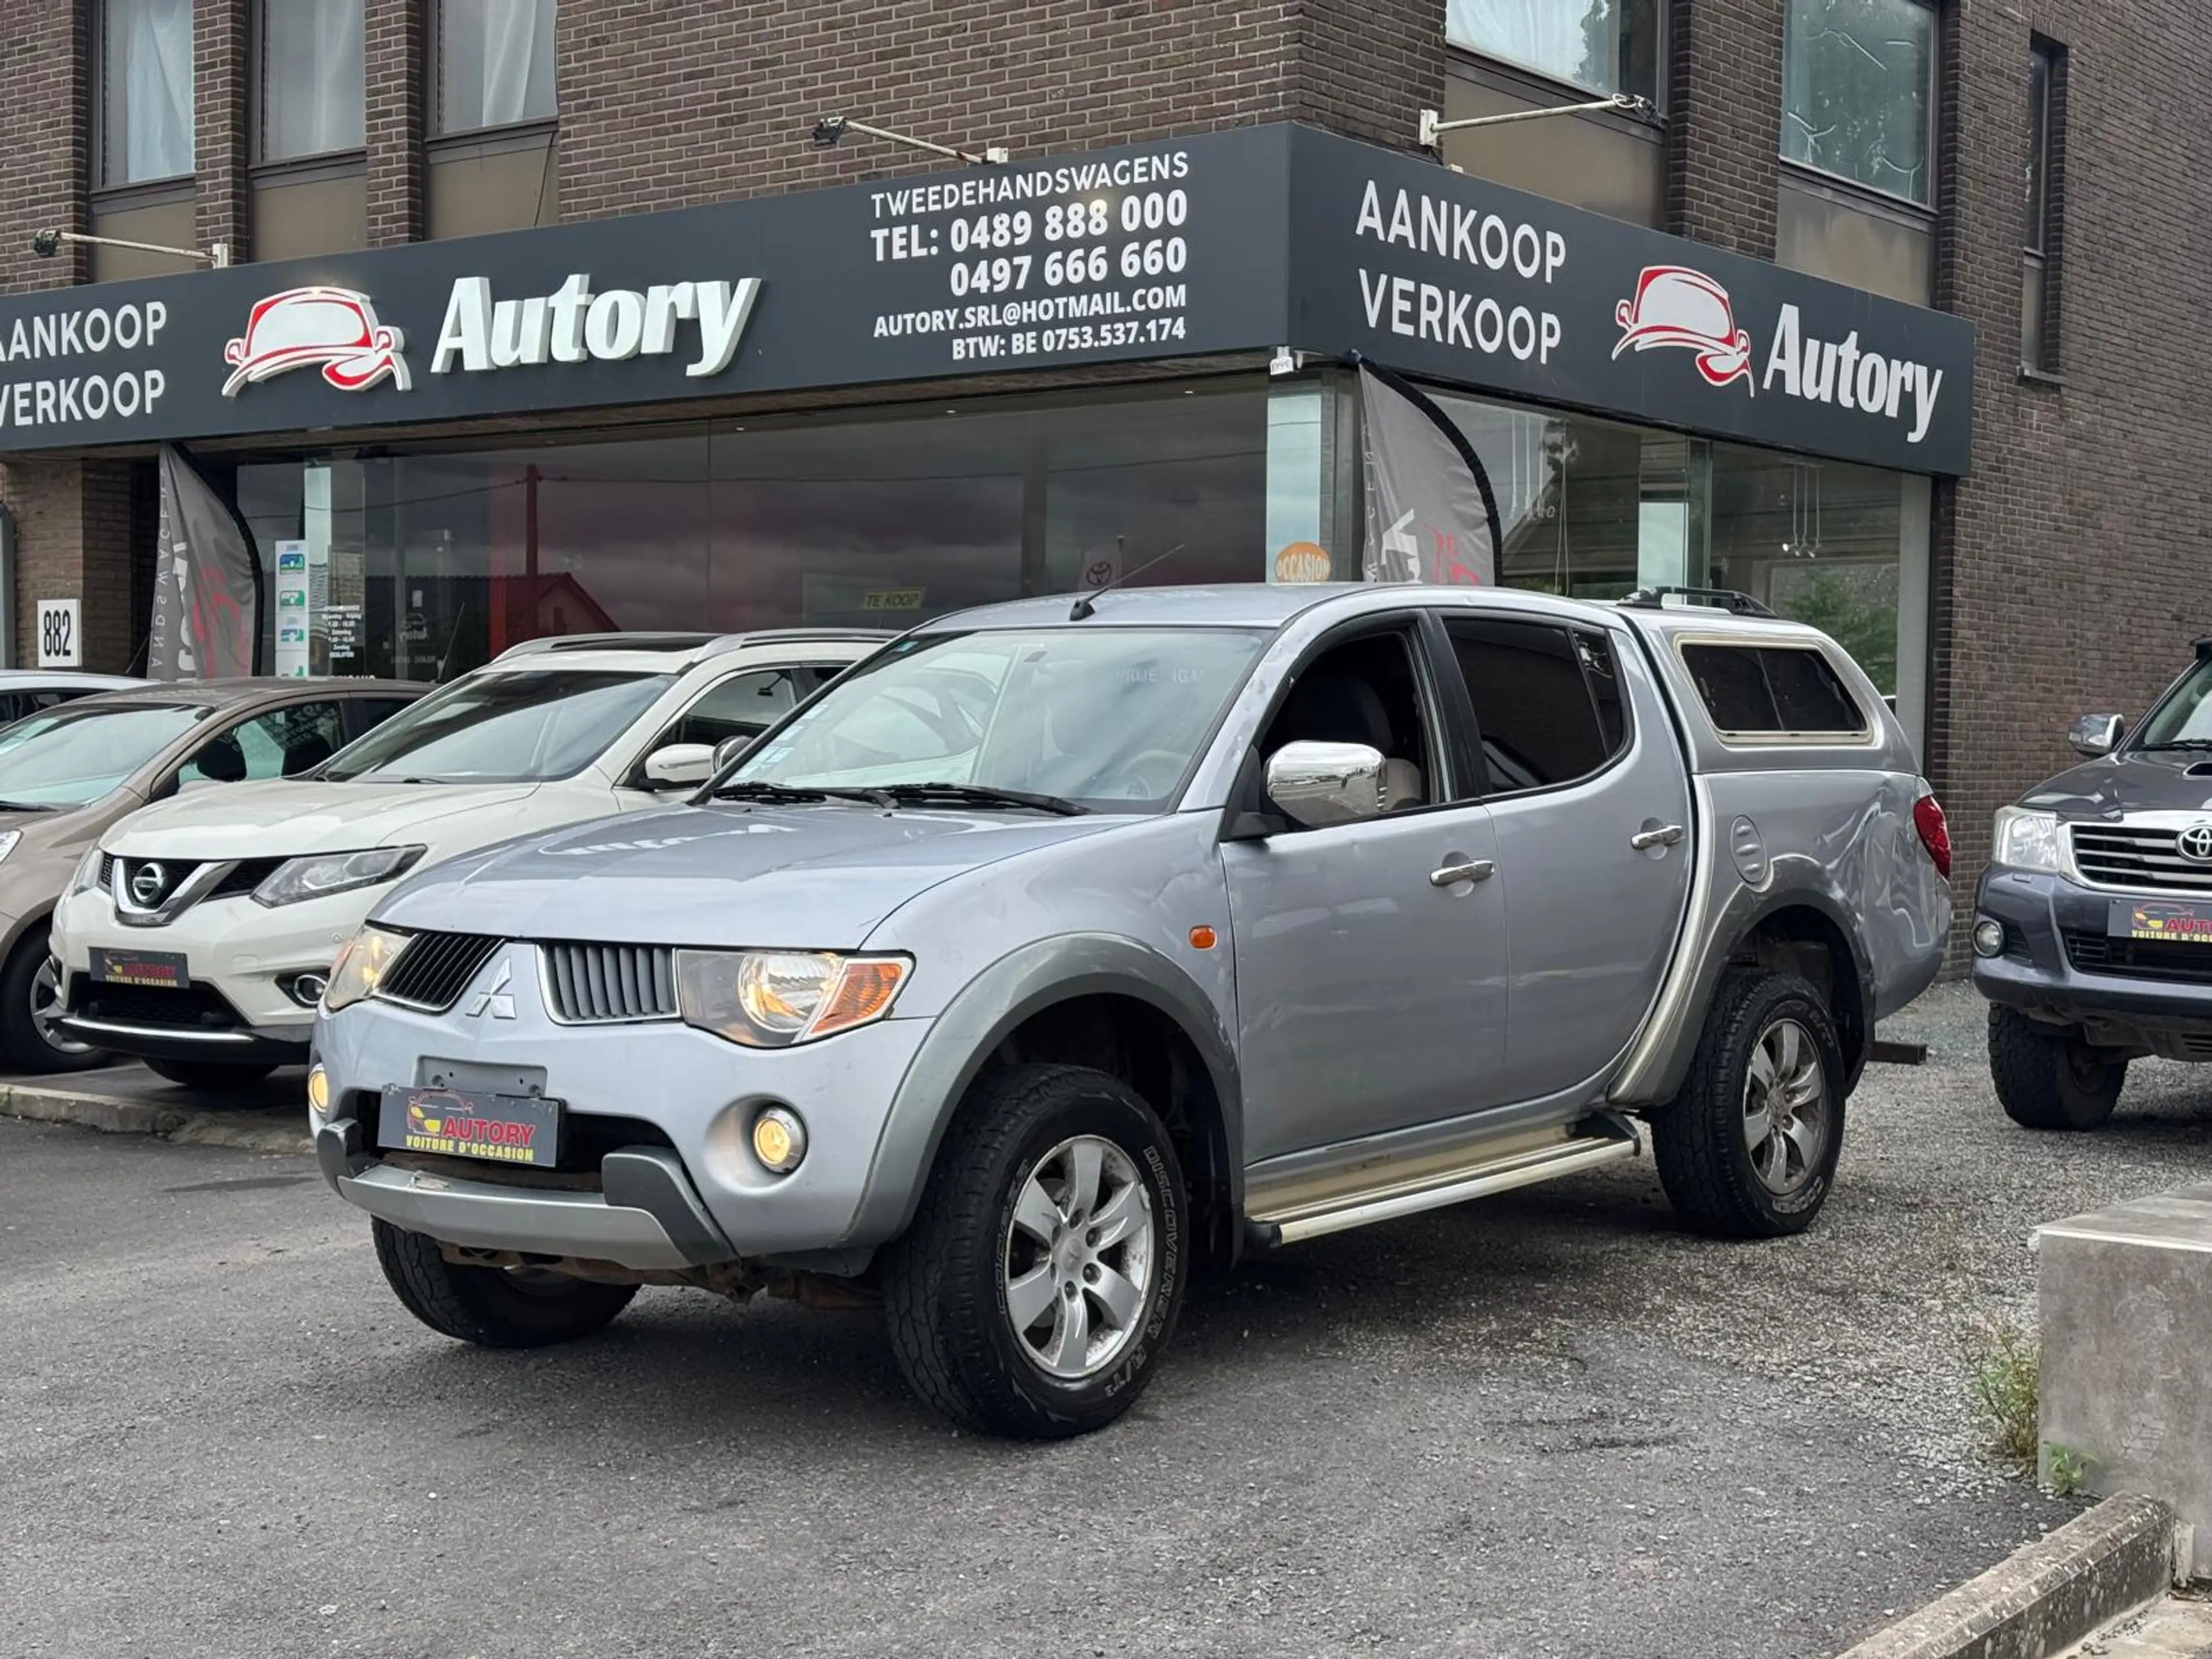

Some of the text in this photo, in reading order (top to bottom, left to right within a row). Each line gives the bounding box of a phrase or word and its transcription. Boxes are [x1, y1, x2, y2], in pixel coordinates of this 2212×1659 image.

[871, 151, 1189, 218] TWEEDEHANDSWAGENS
[870, 189, 1187, 262] TEL: 0489 888 000
[1355, 180, 1566, 283] AANKOOP
[950, 236, 1187, 296] 0497 666 660
[0, 301, 166, 362] ANKOOP
[430, 274, 762, 376] Autory
[873, 284, 1186, 338] AUTORY.SRL@HOTMAIL.COM
[952, 316, 1186, 361] BTW: BE 0753.537.174
[1359, 268, 1561, 365] VERKOOP
[1763, 303, 1943, 443] Autory
[43, 609, 71, 657] 882
[406, 1134, 534, 1162] VOITURE D'OCCASION
[441, 1115, 537, 1147] AUTORY
